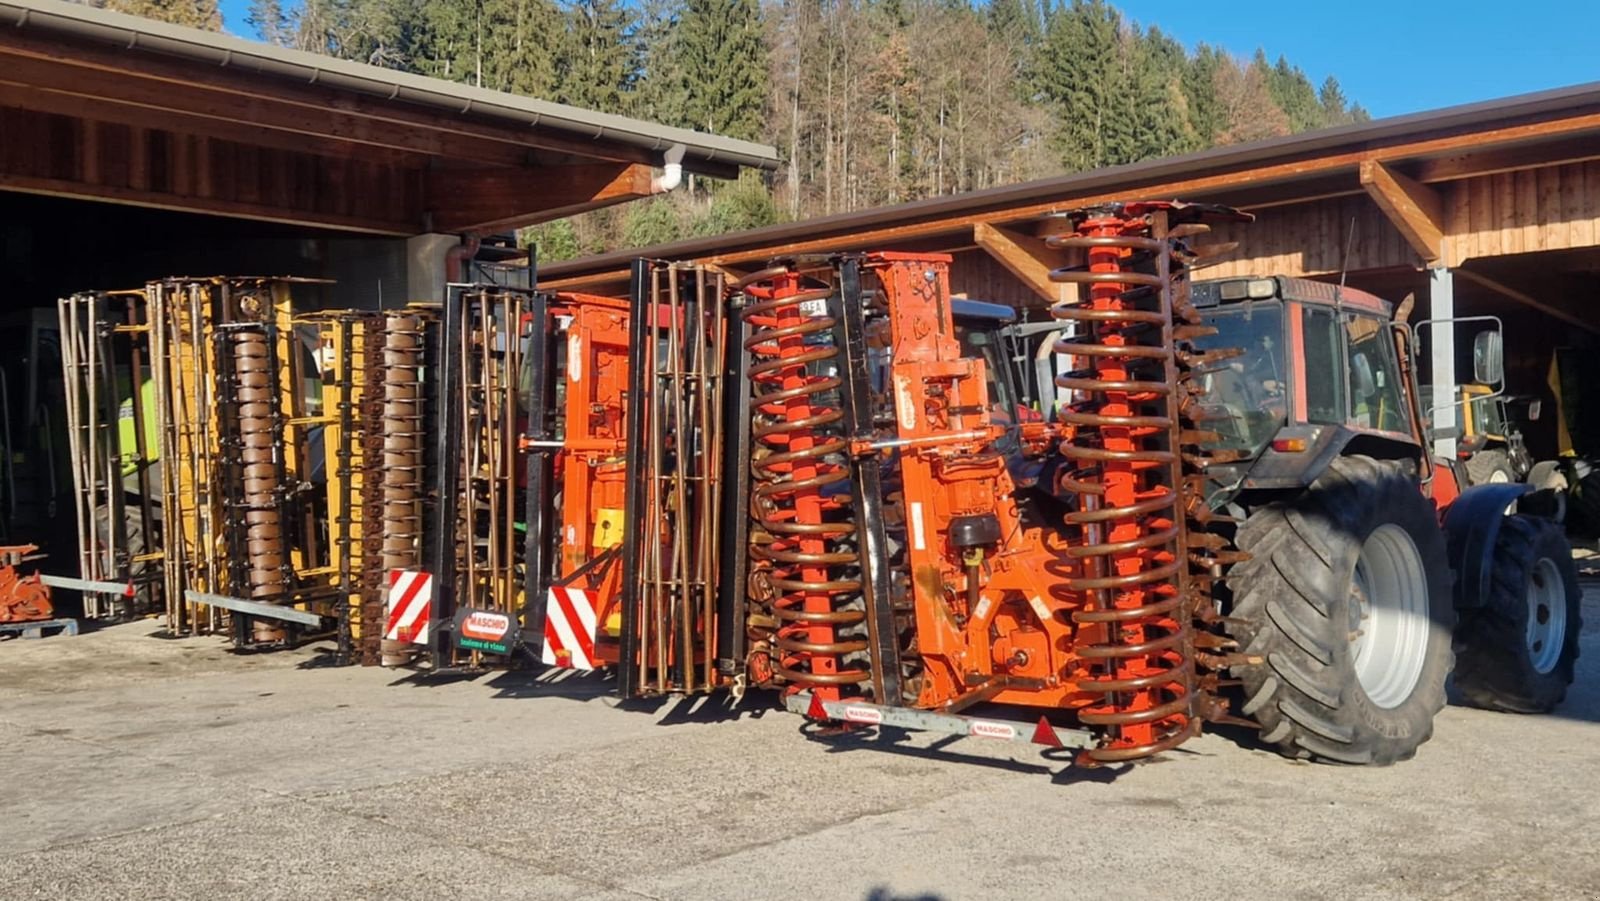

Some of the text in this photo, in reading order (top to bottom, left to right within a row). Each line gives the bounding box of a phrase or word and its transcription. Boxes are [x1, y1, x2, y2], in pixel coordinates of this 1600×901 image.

[468, 614, 507, 630] MASCHIO
[849, 708, 880, 720] MASCHIO
[975, 724, 1012, 735] MASCHIO
